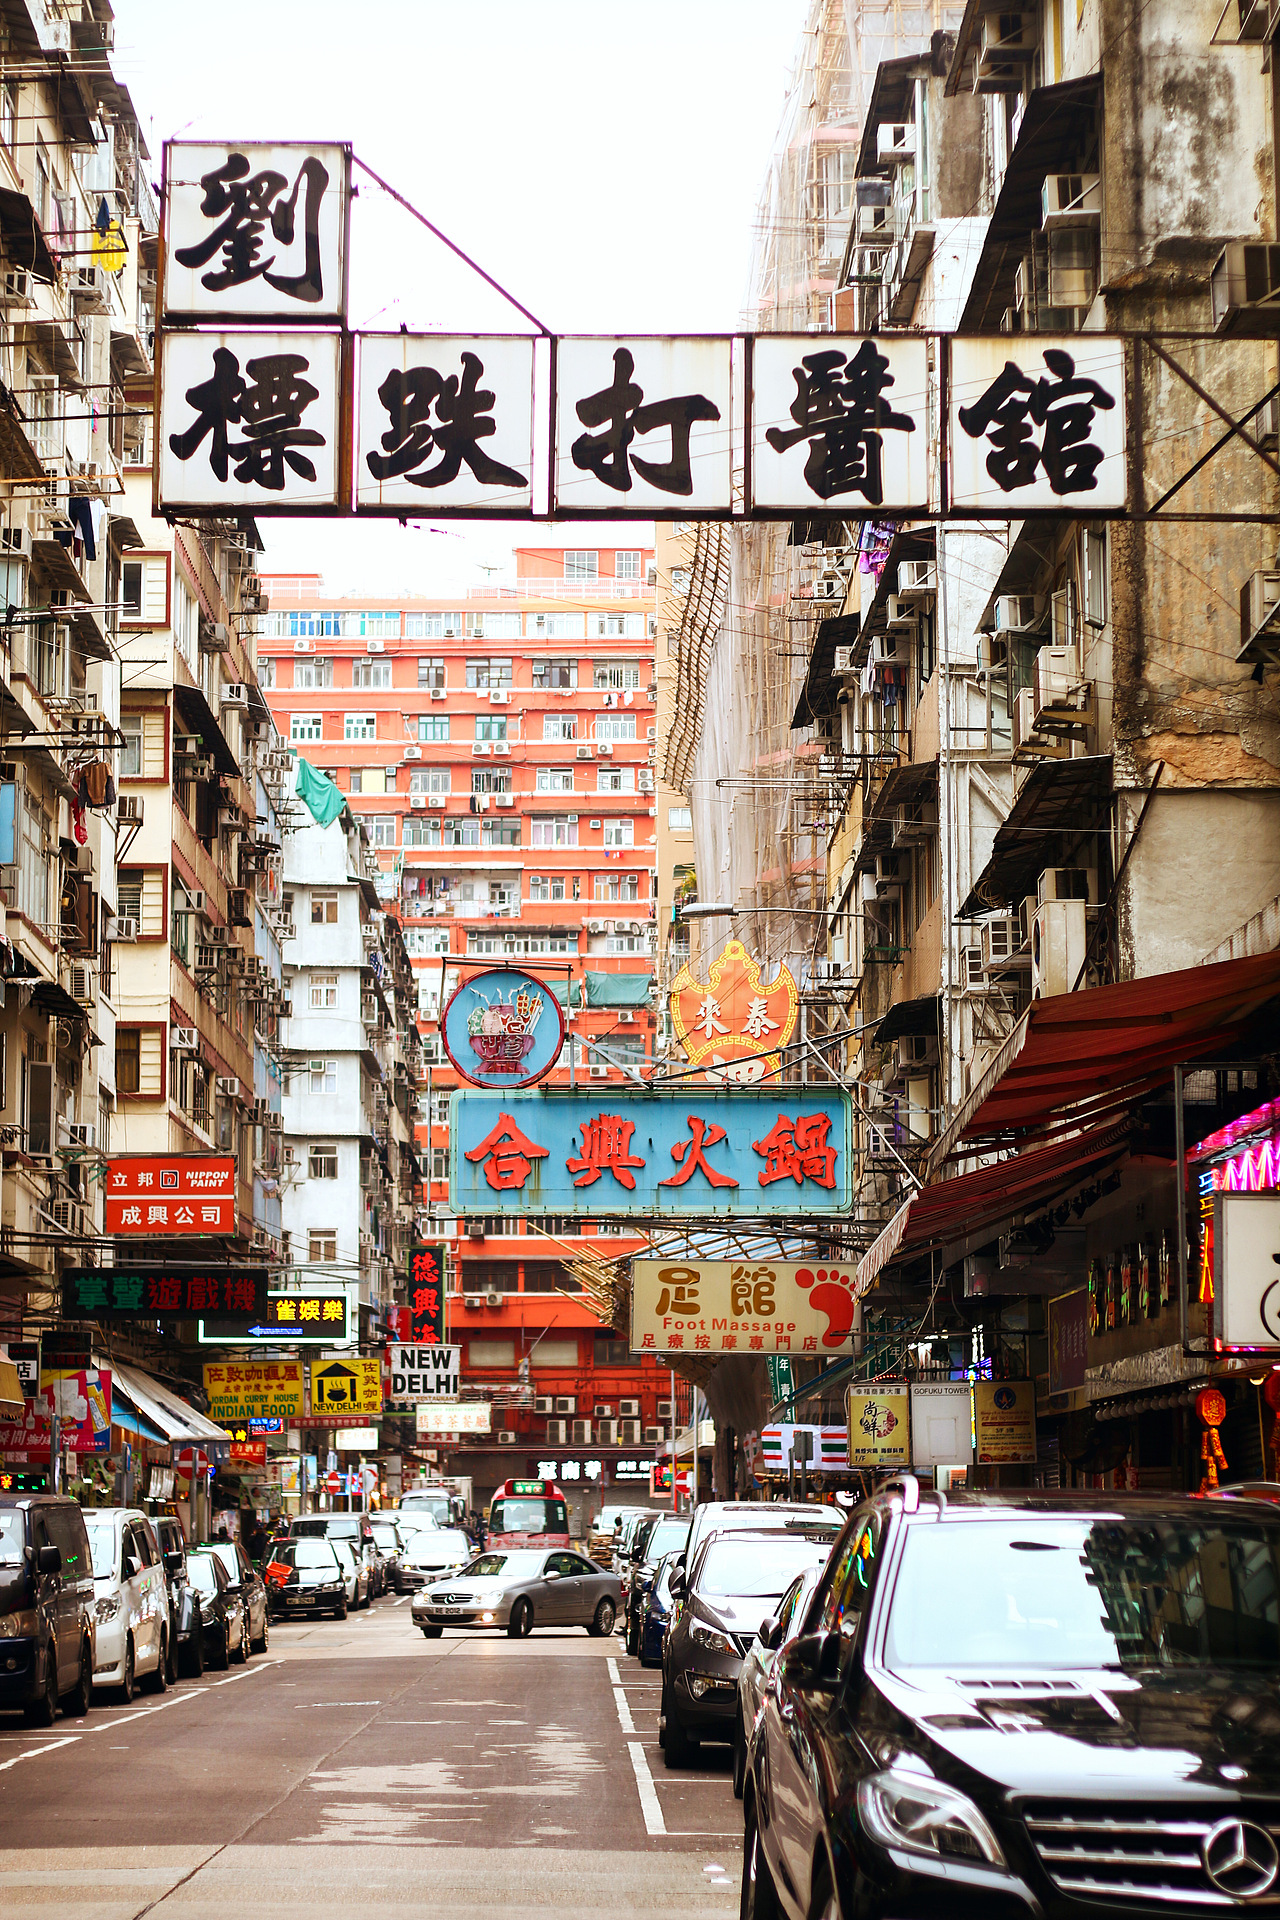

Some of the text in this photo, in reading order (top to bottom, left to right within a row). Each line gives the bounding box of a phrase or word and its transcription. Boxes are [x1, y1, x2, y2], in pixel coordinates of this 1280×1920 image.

[175, 152, 330, 304] 劉
[464, 1111, 838, 1191] 合興火鍋
[112, 1172, 153, 1187] 立邦
[186, 1171, 229, 1179] NIPPON
[190, 1179, 225, 1187] PAINT
[121, 1205, 220, 1225] 成興公司
[655, 1265, 777, 1317] 足館
[663, 1317, 796, 1333] Foot Massage
[641, 1333, 818, 1350] 足療按摩專門店
[400, 1350, 451, 1369] NEW
[392, 1374, 458, 1394] DELHI
[914, 1387, 970, 1395] GOFUKU TOWER
[211, 1393, 299, 1404] JORDAN CURRY HOUSE
[313, 1401, 362, 1411] NEW DELHI
[213, 1403, 296, 1417] INDIAN FOOD
